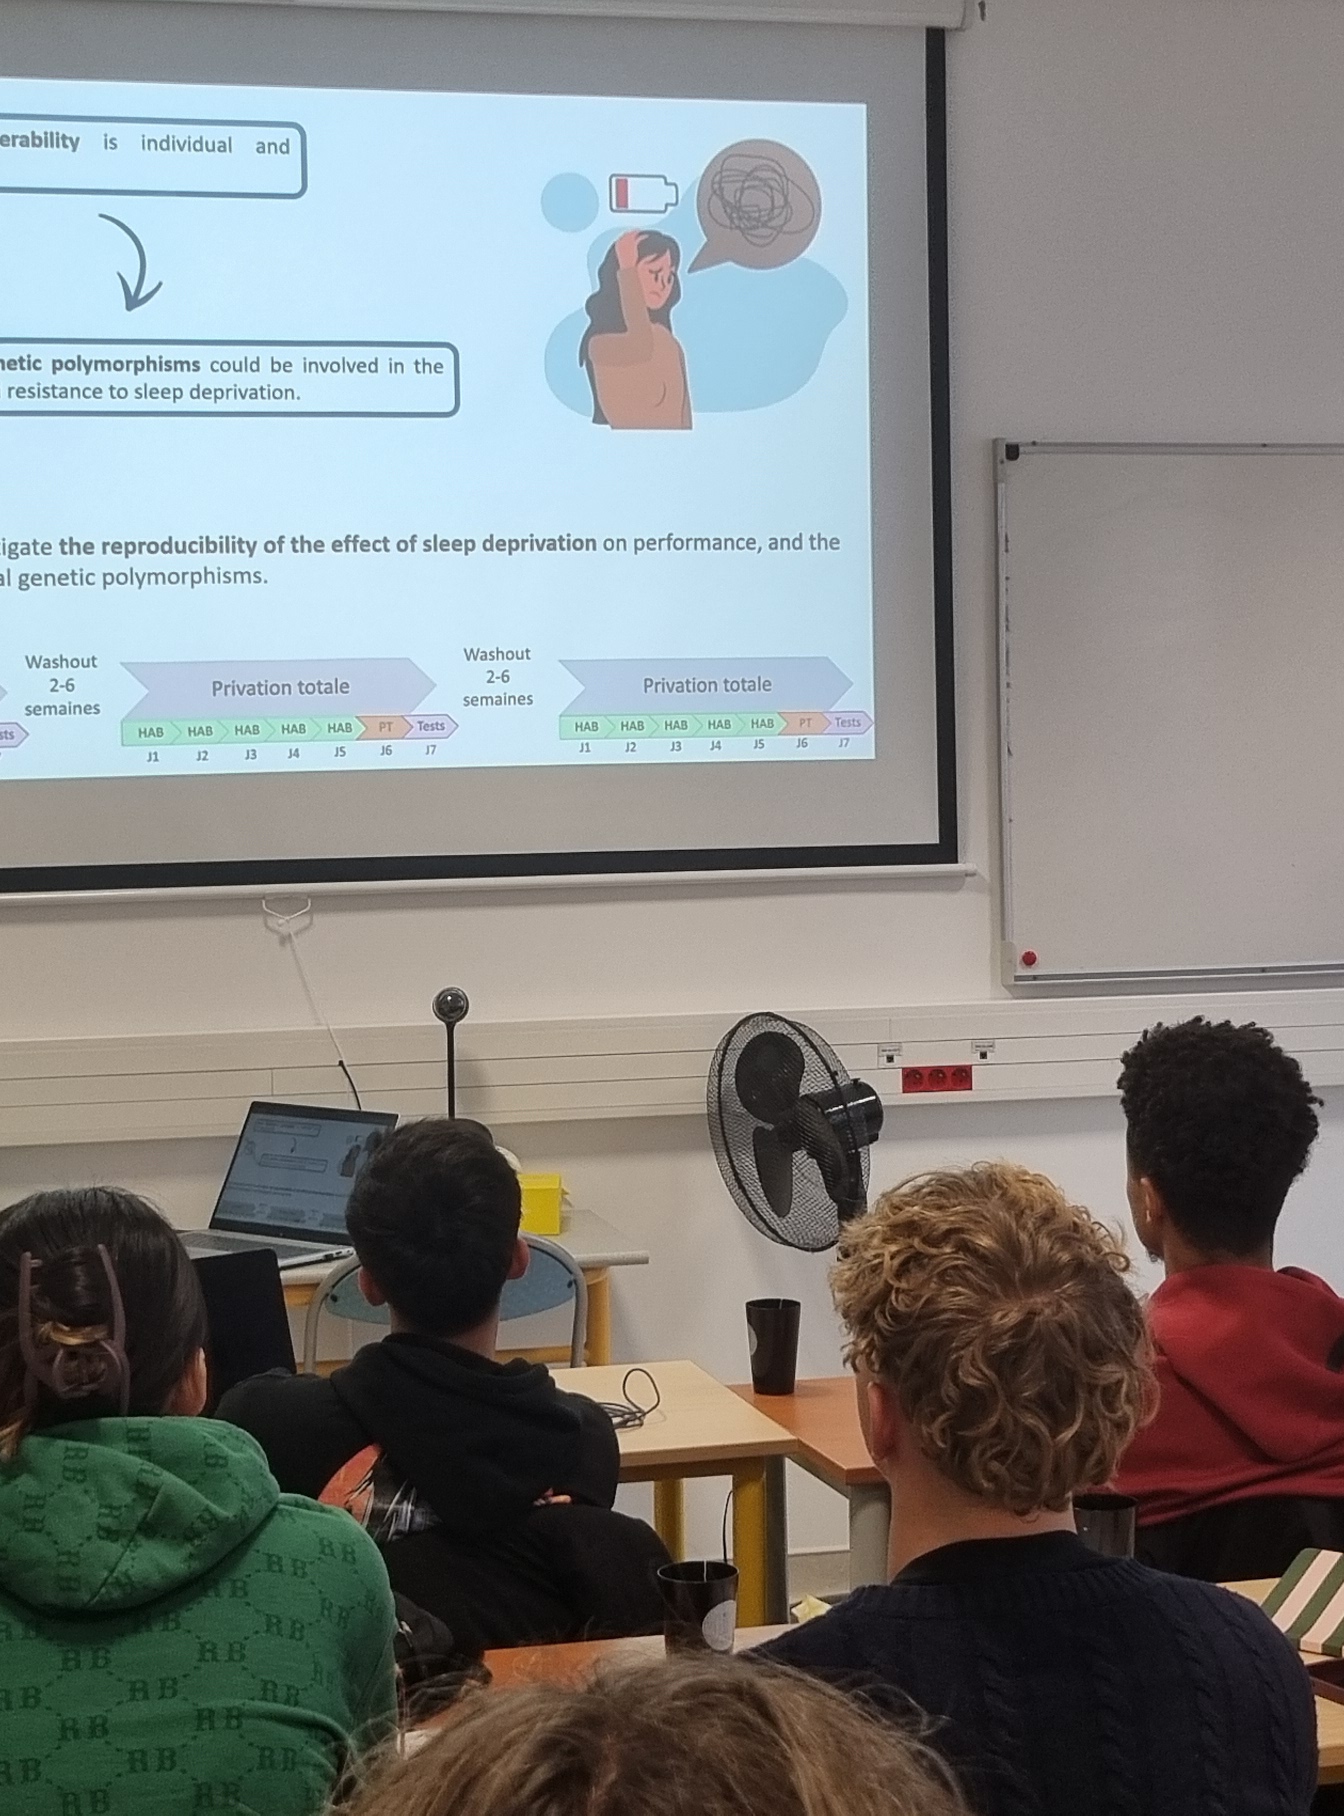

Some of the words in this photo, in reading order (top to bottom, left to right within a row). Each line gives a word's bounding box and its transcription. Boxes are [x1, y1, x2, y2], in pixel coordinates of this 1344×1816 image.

[103, 132, 119, 151] is
[140, 133, 233, 154] individual
[255, 137, 291, 156] and
[51, 353, 202, 377] polymorphisms
[209, 355, 261, 374] could
[270, 355, 294, 374] be
[302, 355, 379, 375] involved
[388, 356, 405, 375] in
[412, 356, 445, 375] the
[7, 381, 104, 400] resistance
[107, 383, 129, 400] to
[133, 381, 184, 405] sleep
[188, 382, 301, 405] deprivation.
[58, 535, 96, 556] the
[101, 534, 259, 560] reproducibility
[263, 534, 287, 555] of
[289, 533, 326, 554] the
[330, 533, 391, 554] effect
[395, 533, 419, 554] of
[422, 532, 477, 557] sleep
[481, 532, 598, 557] deprivation
[602, 537, 628, 552] on
[633, 531, 763, 556] performance,
[767, 531, 804, 552] and
[808, 531, 841, 551] the
[17, 567, 97, 592] genetic
[101, 565, 269, 591] polymorphisms.
[24, 653, 99, 670] Washout
[462, 645, 532, 662] Washout
[49, 677, 76, 693] 2-6
[485, 668, 511, 685] 2-6
[643, 676, 718, 694] Privation
[722, 675, 773, 693] totale
[211, 679, 292, 697] Privation
[296, 676, 351, 696] totale
[24, 700, 102, 717] semaines
[462, 691, 534, 708] semaines
[137, 726, 165, 739] HAB
[187, 725, 214, 738] HAB
[234, 724, 261, 737] HAB
[281, 723, 307, 735] HAB
[327, 722, 353, 734] HAB
[378, 721, 395, 733] PT
[416, 720, 446, 732] Tests
[574, 720, 600, 733] HAB
[620, 720, 645, 732] HAB
[664, 719, 689, 732] HAB
[707, 718, 732, 731] HAB
[750, 718, 775, 730] HAB
[799, 717, 813, 728] PT
[834, 716, 862, 728] Tests
[146, 750, 160, 763] J1
[195, 749, 210, 762] J2
[244, 748, 258, 761] J3
[287, 747, 301, 760] J4
[333, 745, 347, 758] J5
[379, 744, 393, 757] J6
[424, 743, 437, 756] J7
[578, 741, 592, 754] J1
[624, 741, 637, 754] J2
[669, 740, 683, 753] J3
[709, 739, 722, 752] J4
[753, 738, 765, 750] J5
[795, 737, 809, 749] J6
[838, 737, 851, 748] J7
